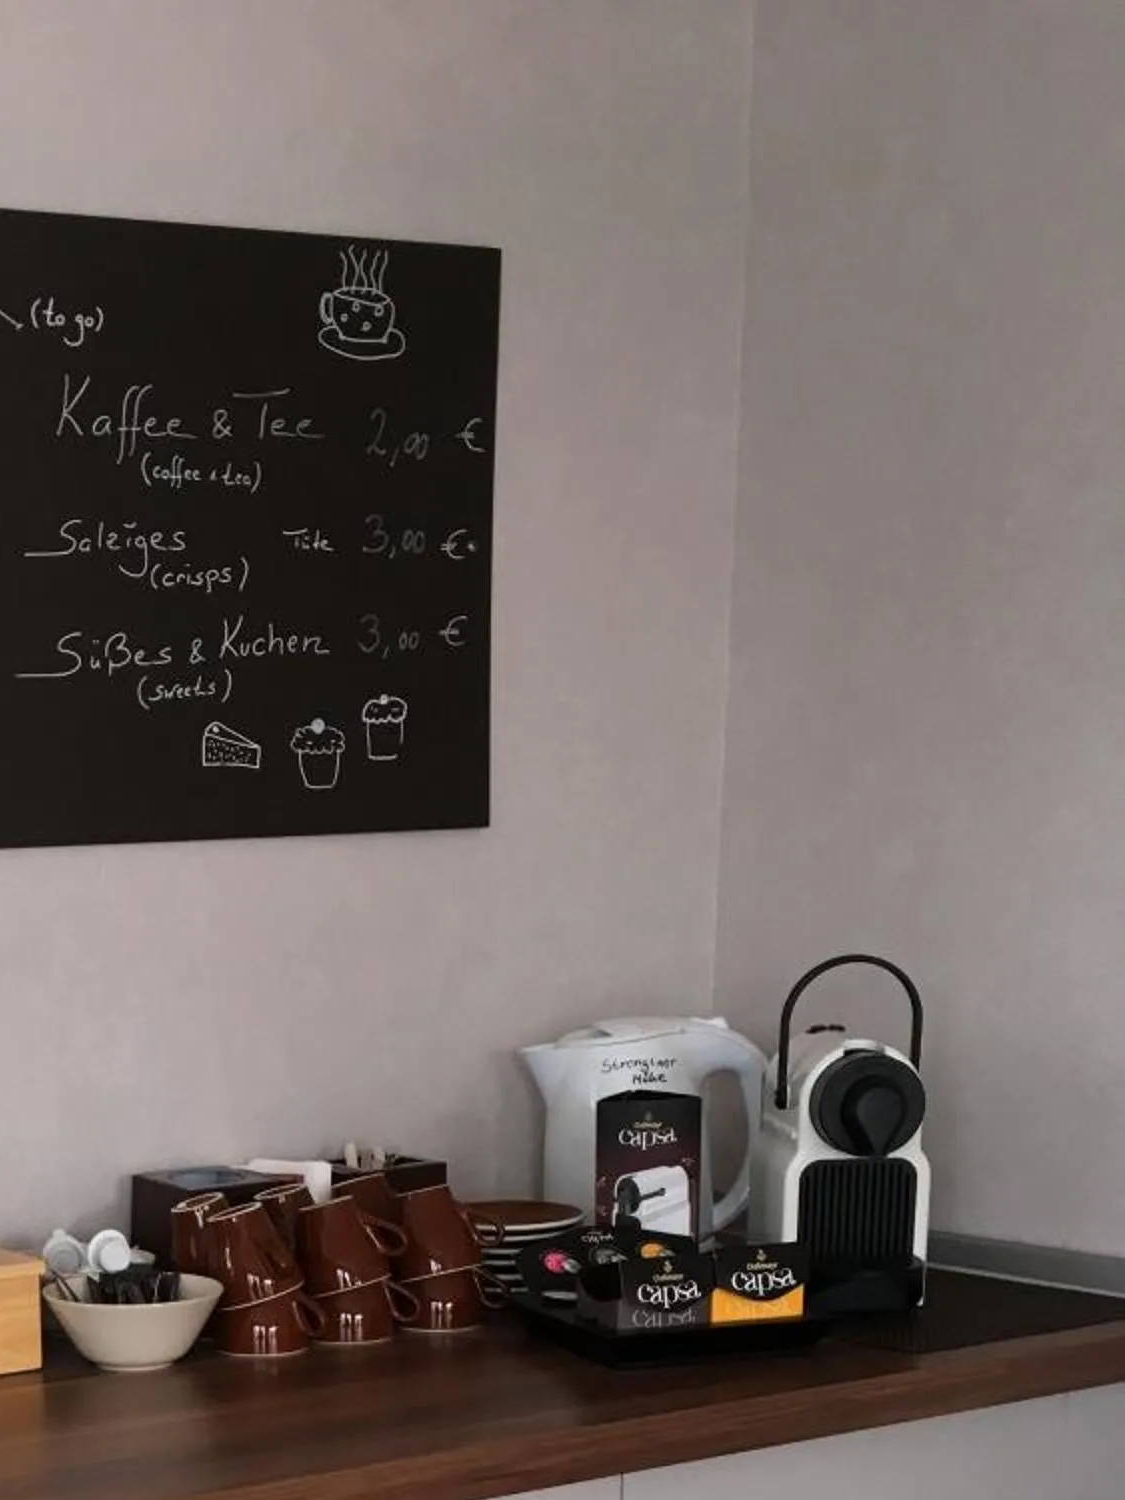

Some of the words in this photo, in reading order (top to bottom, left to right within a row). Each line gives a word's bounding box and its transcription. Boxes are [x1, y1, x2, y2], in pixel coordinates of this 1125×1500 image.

[29, 296, 66, 331] (to
[63, 305, 105, 347] go)
[55, 374, 198, 465] Kaffee
[212, 409, 234, 440] &
[232, 387, 326, 440] Tee
[366, 407, 430, 467] 2,00
[456, 417, 487, 453] €
[141, 453, 201, 489] (coffee
[222, 460, 262, 493] tea)
[24, 518, 187, 578] Salziges
[363, 514, 426, 558] 3,00
[150, 556, 250, 592] (crisps)
[15, 631, 174, 678] Süßes
[188, 634, 205, 664] &
[219, 615, 331, 660] Kuchen
[356, 612, 421, 659] 3,00
[439, 615, 468, 647] €
[137, 669, 233, 710] (sweets)
[637, 1279, 701, 1309] capsa
[731, 1267, 798, 1297] capsa
